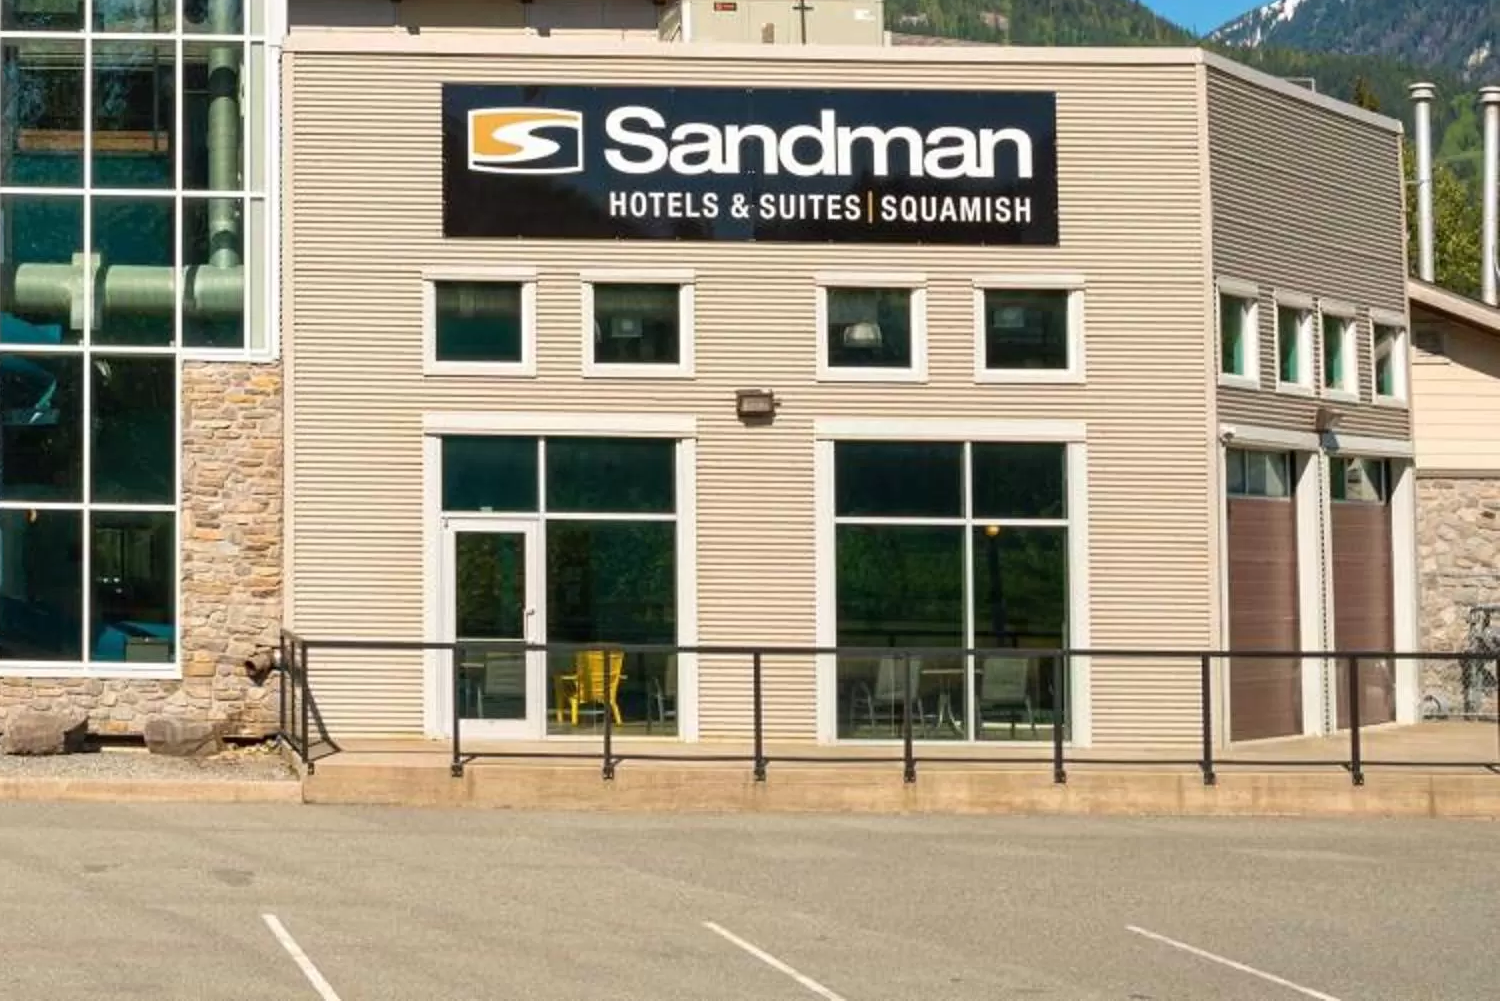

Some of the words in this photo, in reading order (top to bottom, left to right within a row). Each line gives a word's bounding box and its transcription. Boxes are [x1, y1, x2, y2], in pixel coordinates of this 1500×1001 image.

[603, 105, 1033, 179] Sandman
[609, 191, 719, 218] HOTELS
[730, 192, 750, 218] &
[759, 193, 861, 221] SUITES
[881, 194, 1031, 223] SQUAMISH
